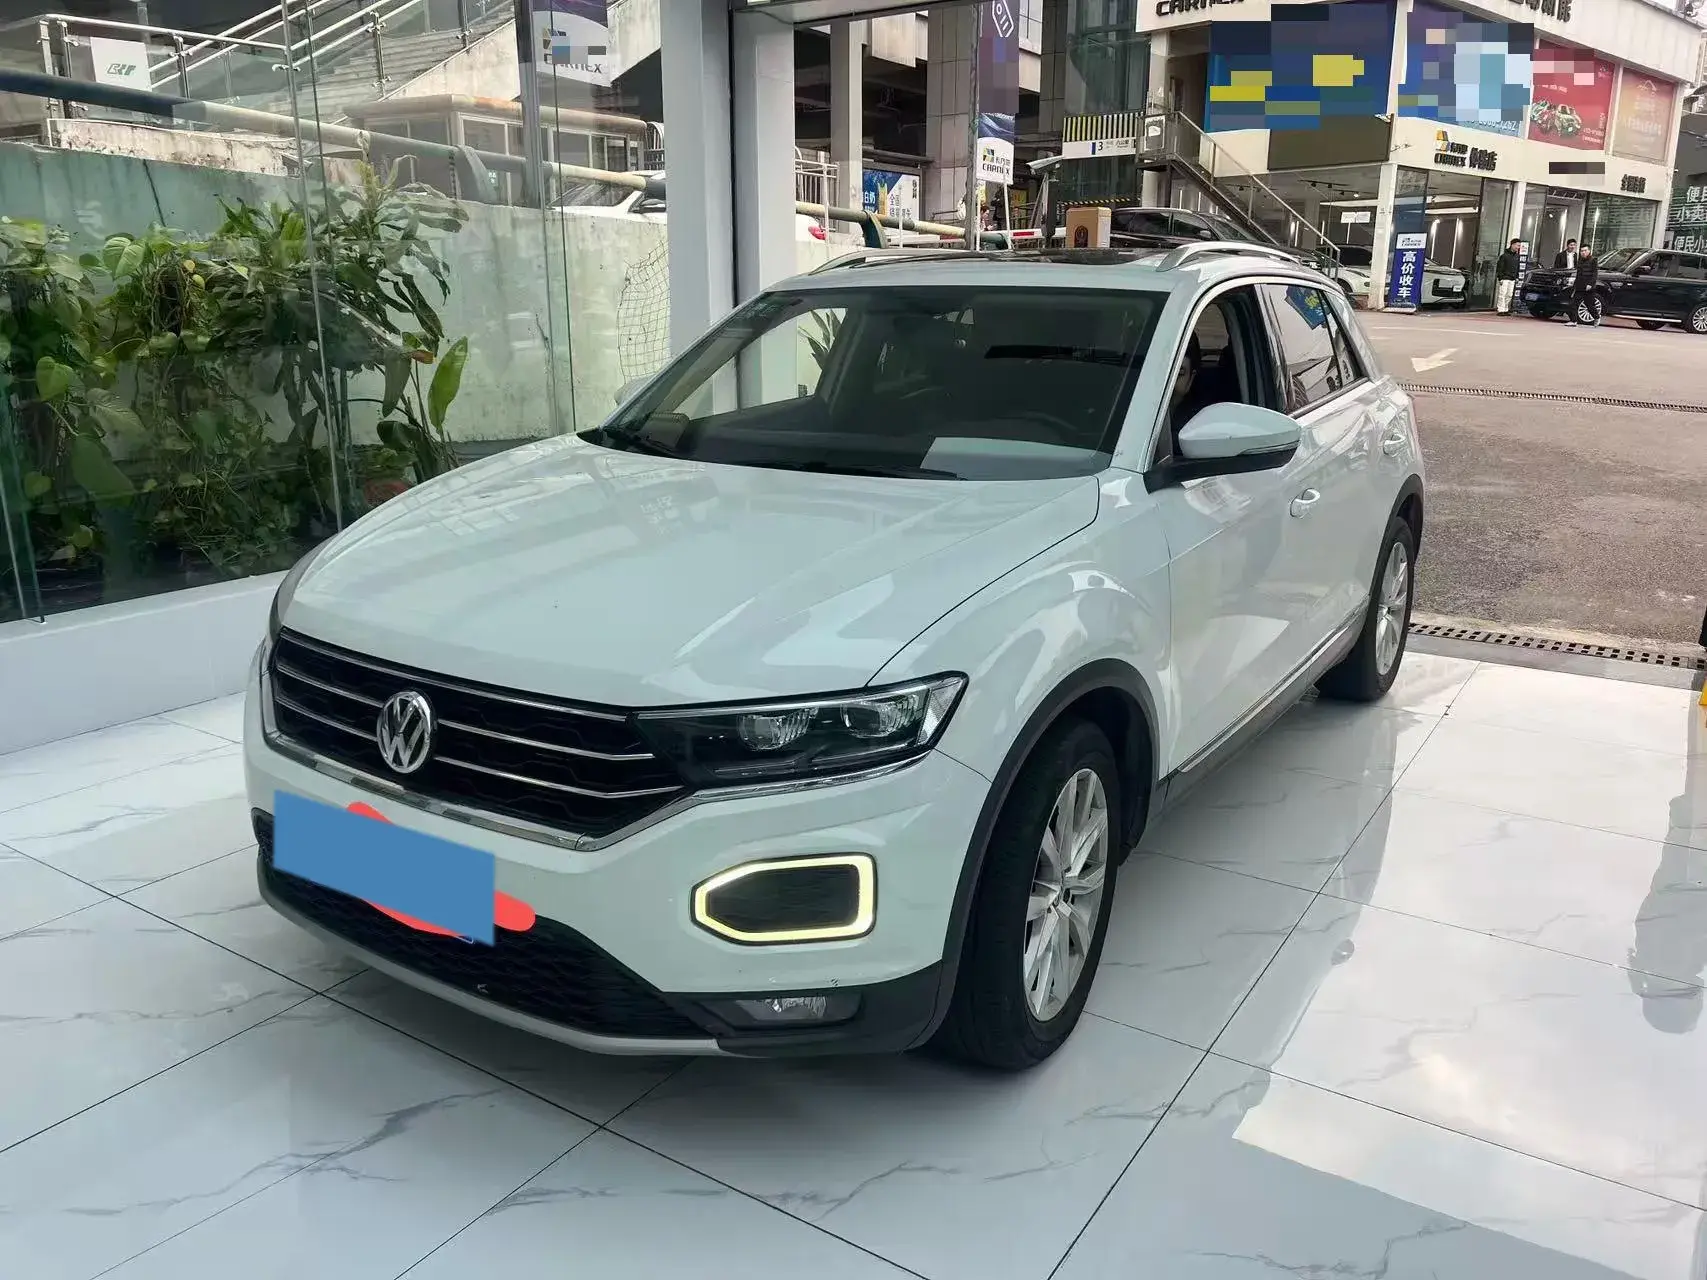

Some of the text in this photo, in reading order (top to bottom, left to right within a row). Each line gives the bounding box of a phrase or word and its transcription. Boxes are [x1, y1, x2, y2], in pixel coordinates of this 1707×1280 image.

[1098, 141, 1104, 151] 3
[1397, 250, 1418, 298] 高价收车
